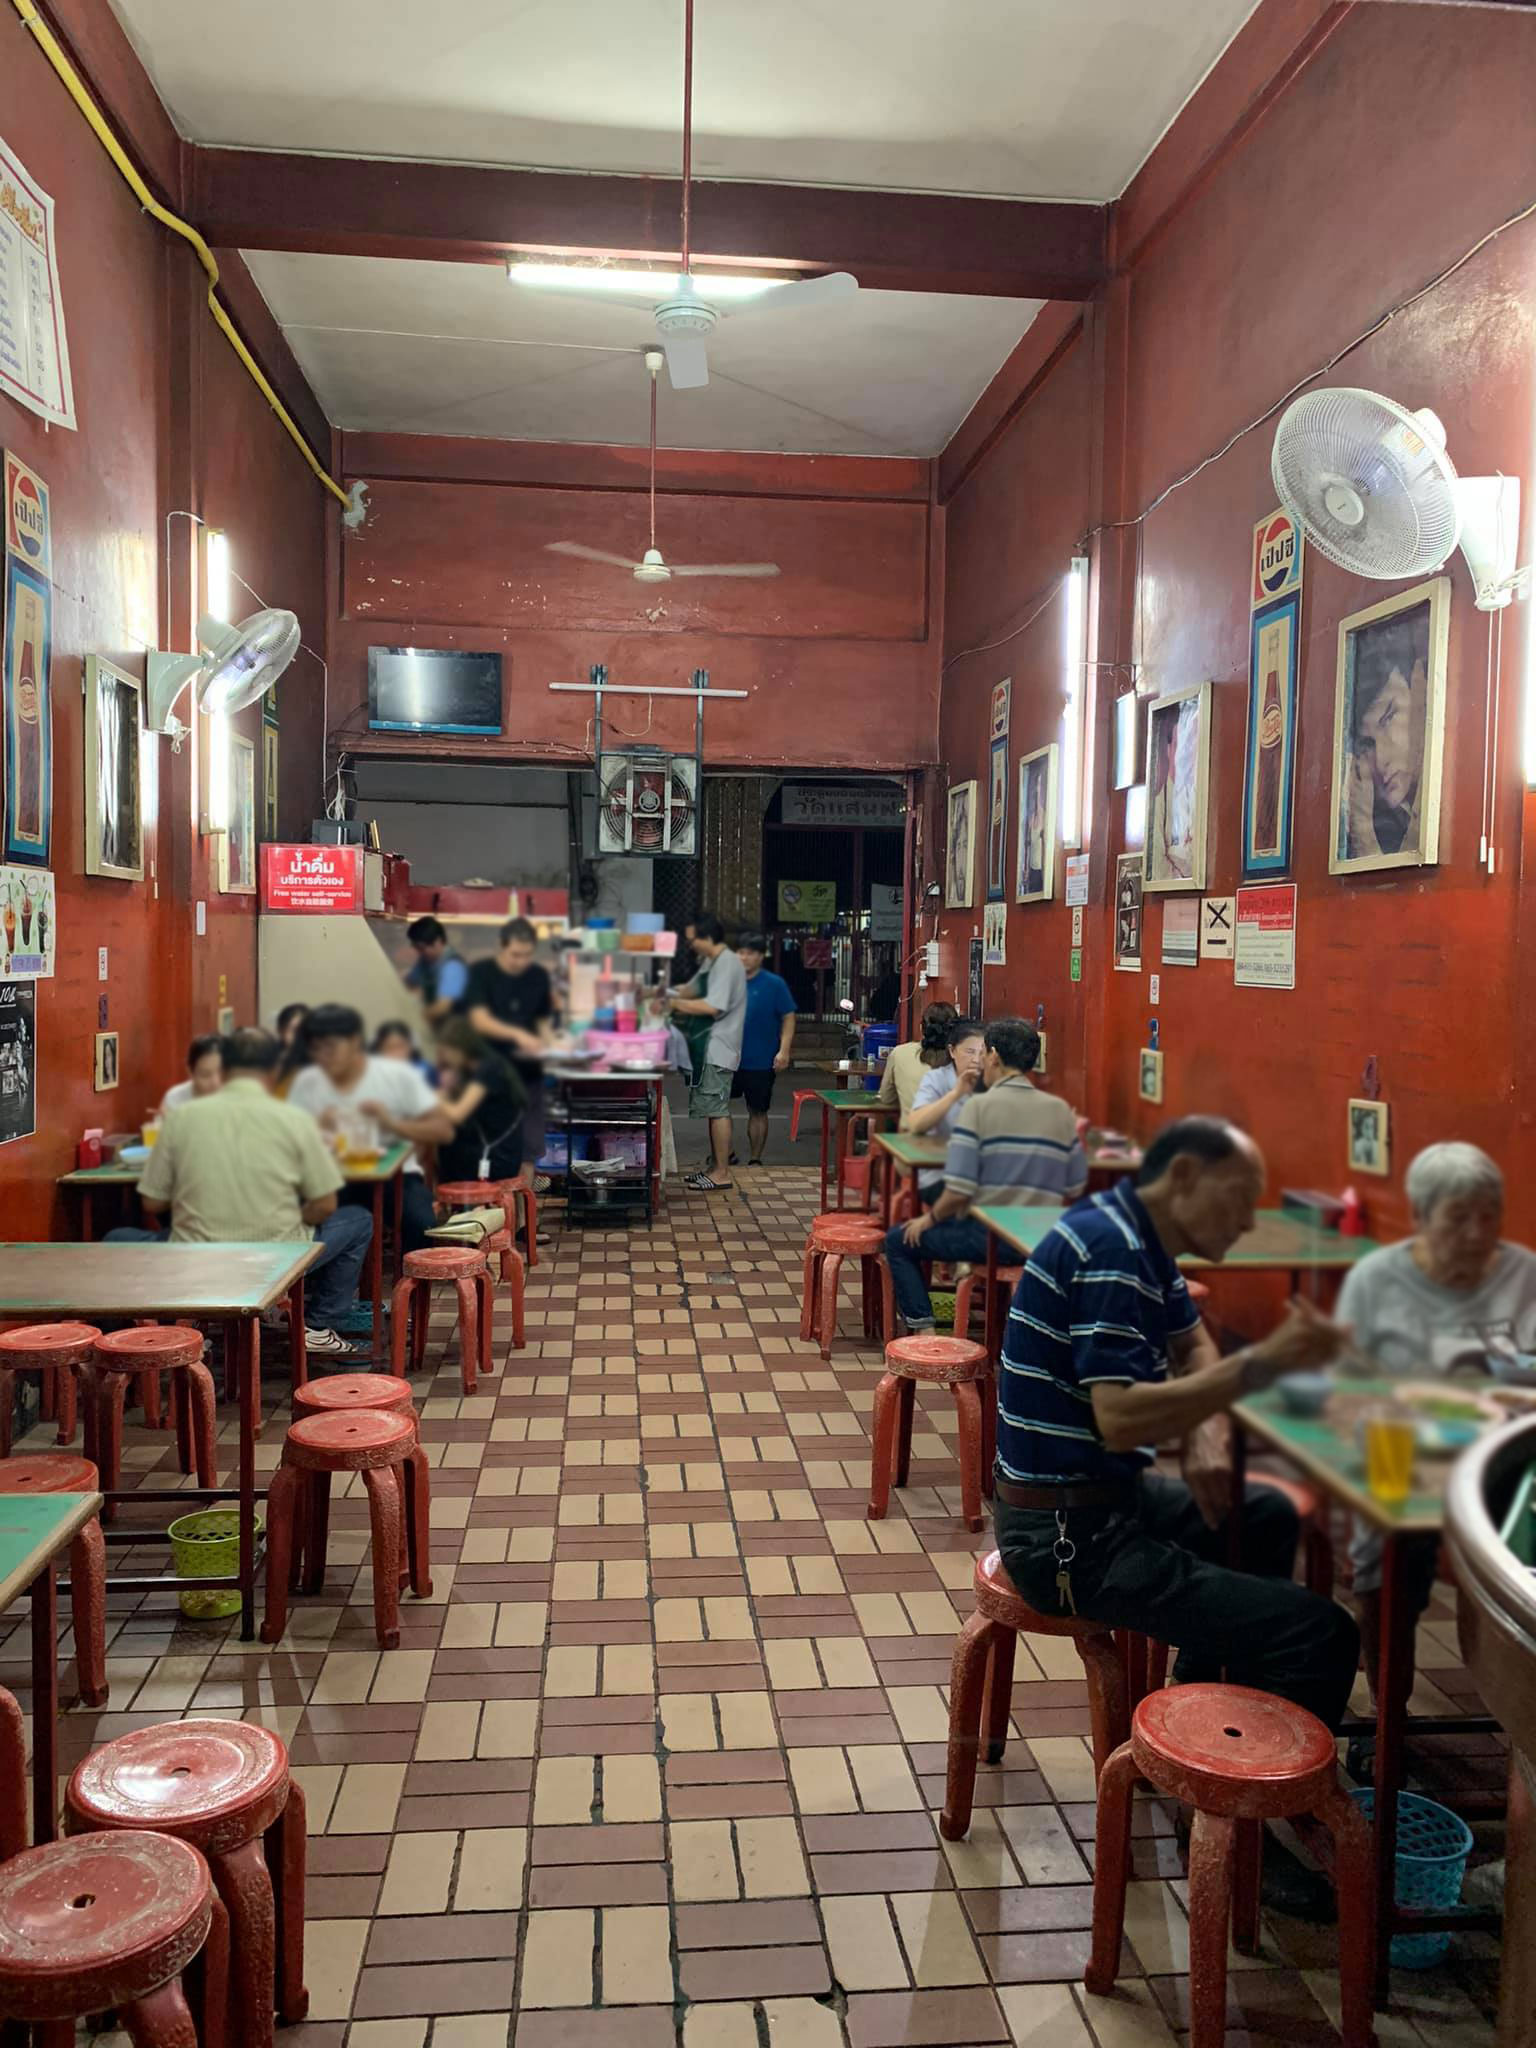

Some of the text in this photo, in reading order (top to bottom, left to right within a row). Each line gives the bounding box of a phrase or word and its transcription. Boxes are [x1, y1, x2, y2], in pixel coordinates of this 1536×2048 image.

[1261, 532, 1294, 572] เป๊ปซี่
[289, 848, 335, 874] น้ำดื่ม
[280, 874, 345, 886] บริการตัวเอง
[273, 889, 290, 897] Free
